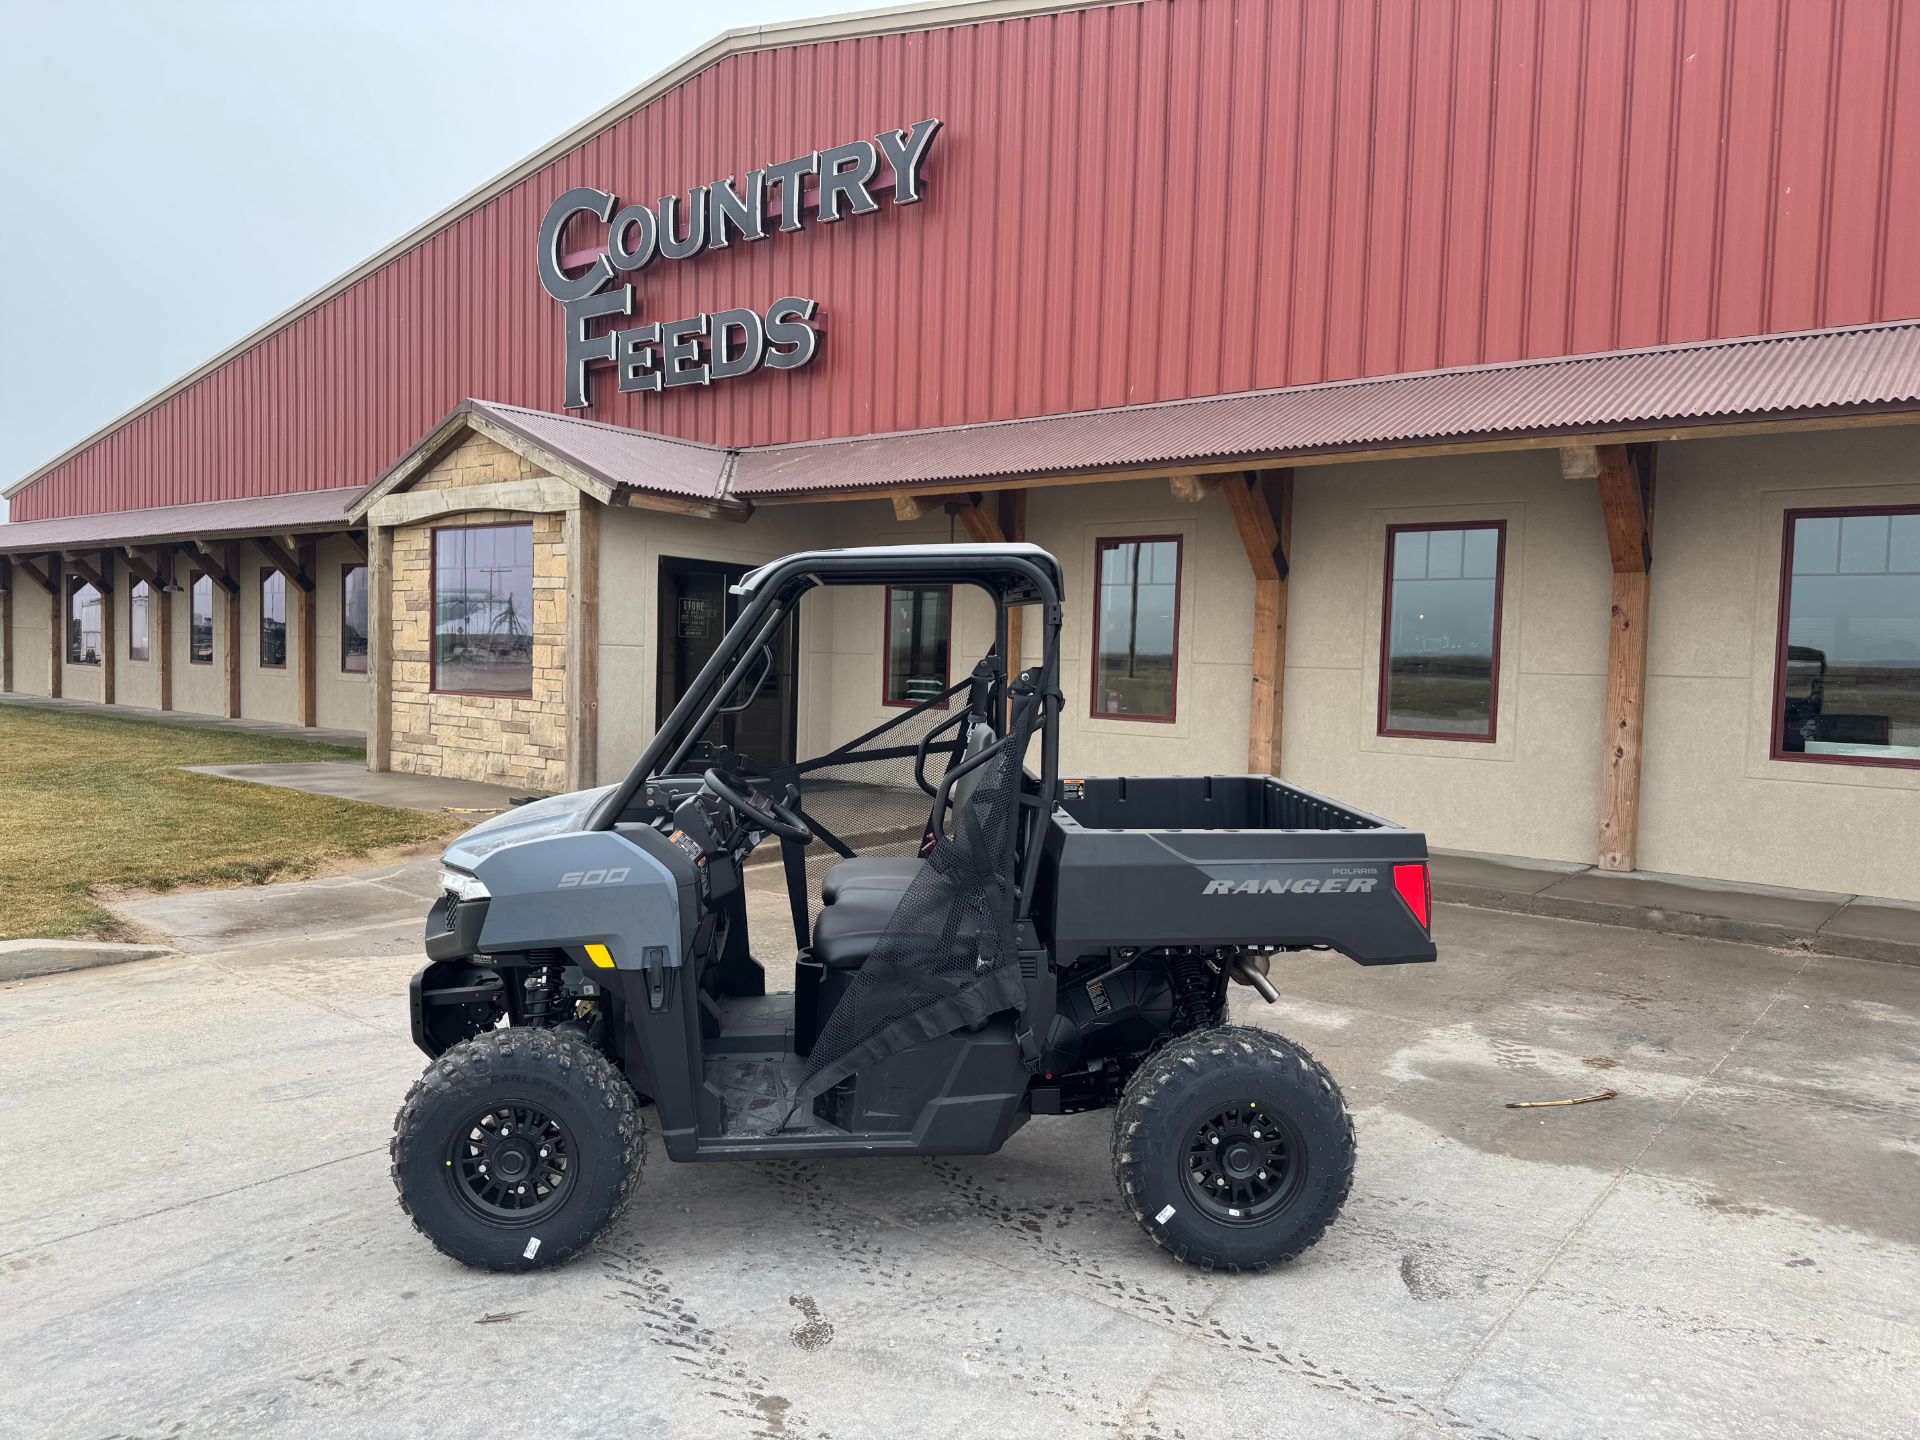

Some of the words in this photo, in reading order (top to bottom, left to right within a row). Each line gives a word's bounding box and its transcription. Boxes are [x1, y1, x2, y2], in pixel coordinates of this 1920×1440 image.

[536, 118, 943, 302] COUNTRY
[562, 283, 820, 409] FEEDS
[558, 867, 631, 888] 500
[1202, 878, 1378, 895] RANGER
